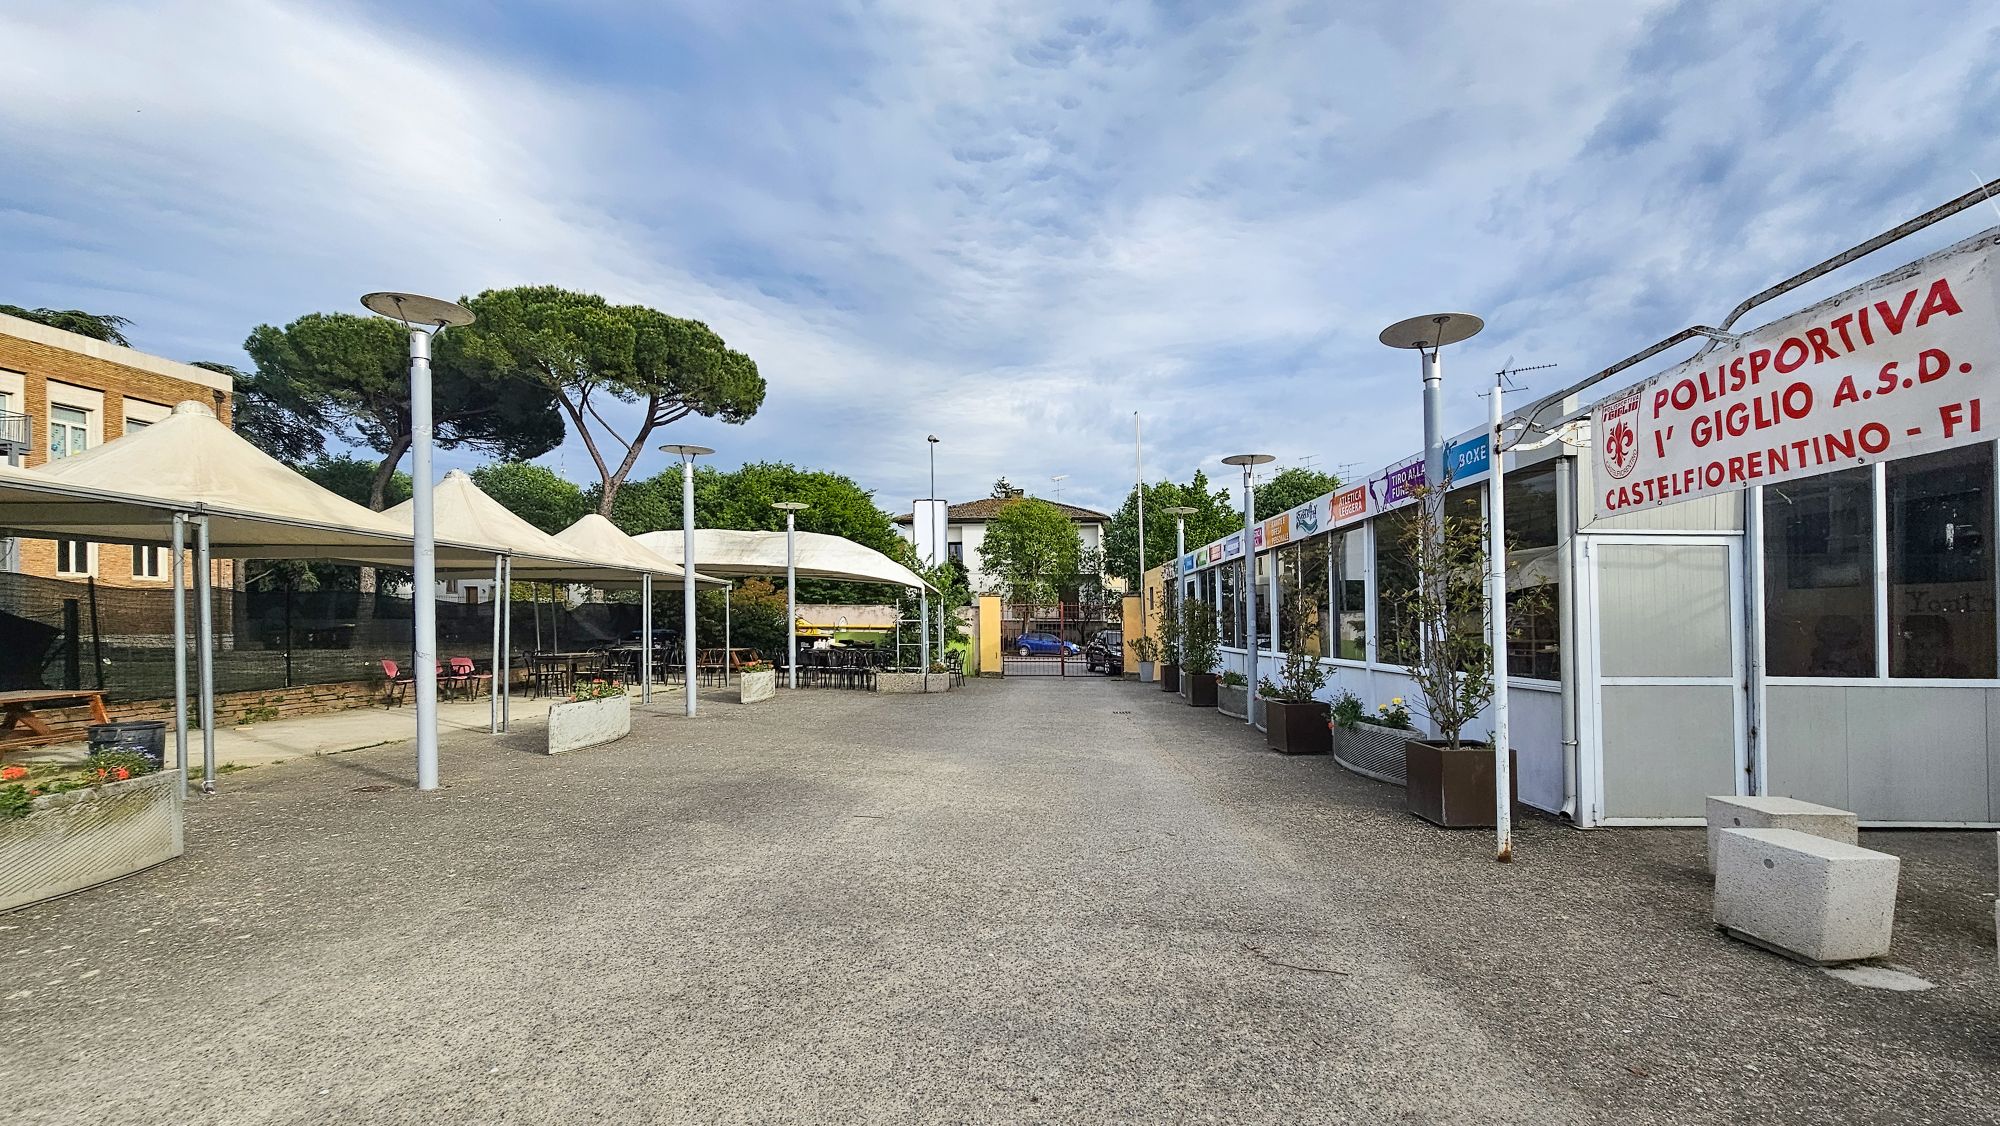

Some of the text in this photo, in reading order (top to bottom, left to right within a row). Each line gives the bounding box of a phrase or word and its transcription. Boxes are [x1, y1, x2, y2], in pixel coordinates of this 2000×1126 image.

[1654, 278, 1962, 418] POLISPORTIVA
[1691, 382, 1813, 448] GIGLIO
[1833, 348, 1972, 408] A.S.D.
[1459, 445, 1486, 468] BOXE
[1606, 422, 1890, 510] CASTELFIORENTINO
[1938, 399, 1981, 438] FI
[1391, 471, 1407, 486] TIRO
[1338, 490, 1362, 507] ATLETICA
[1339, 501, 1363, 518] LEGGERA
